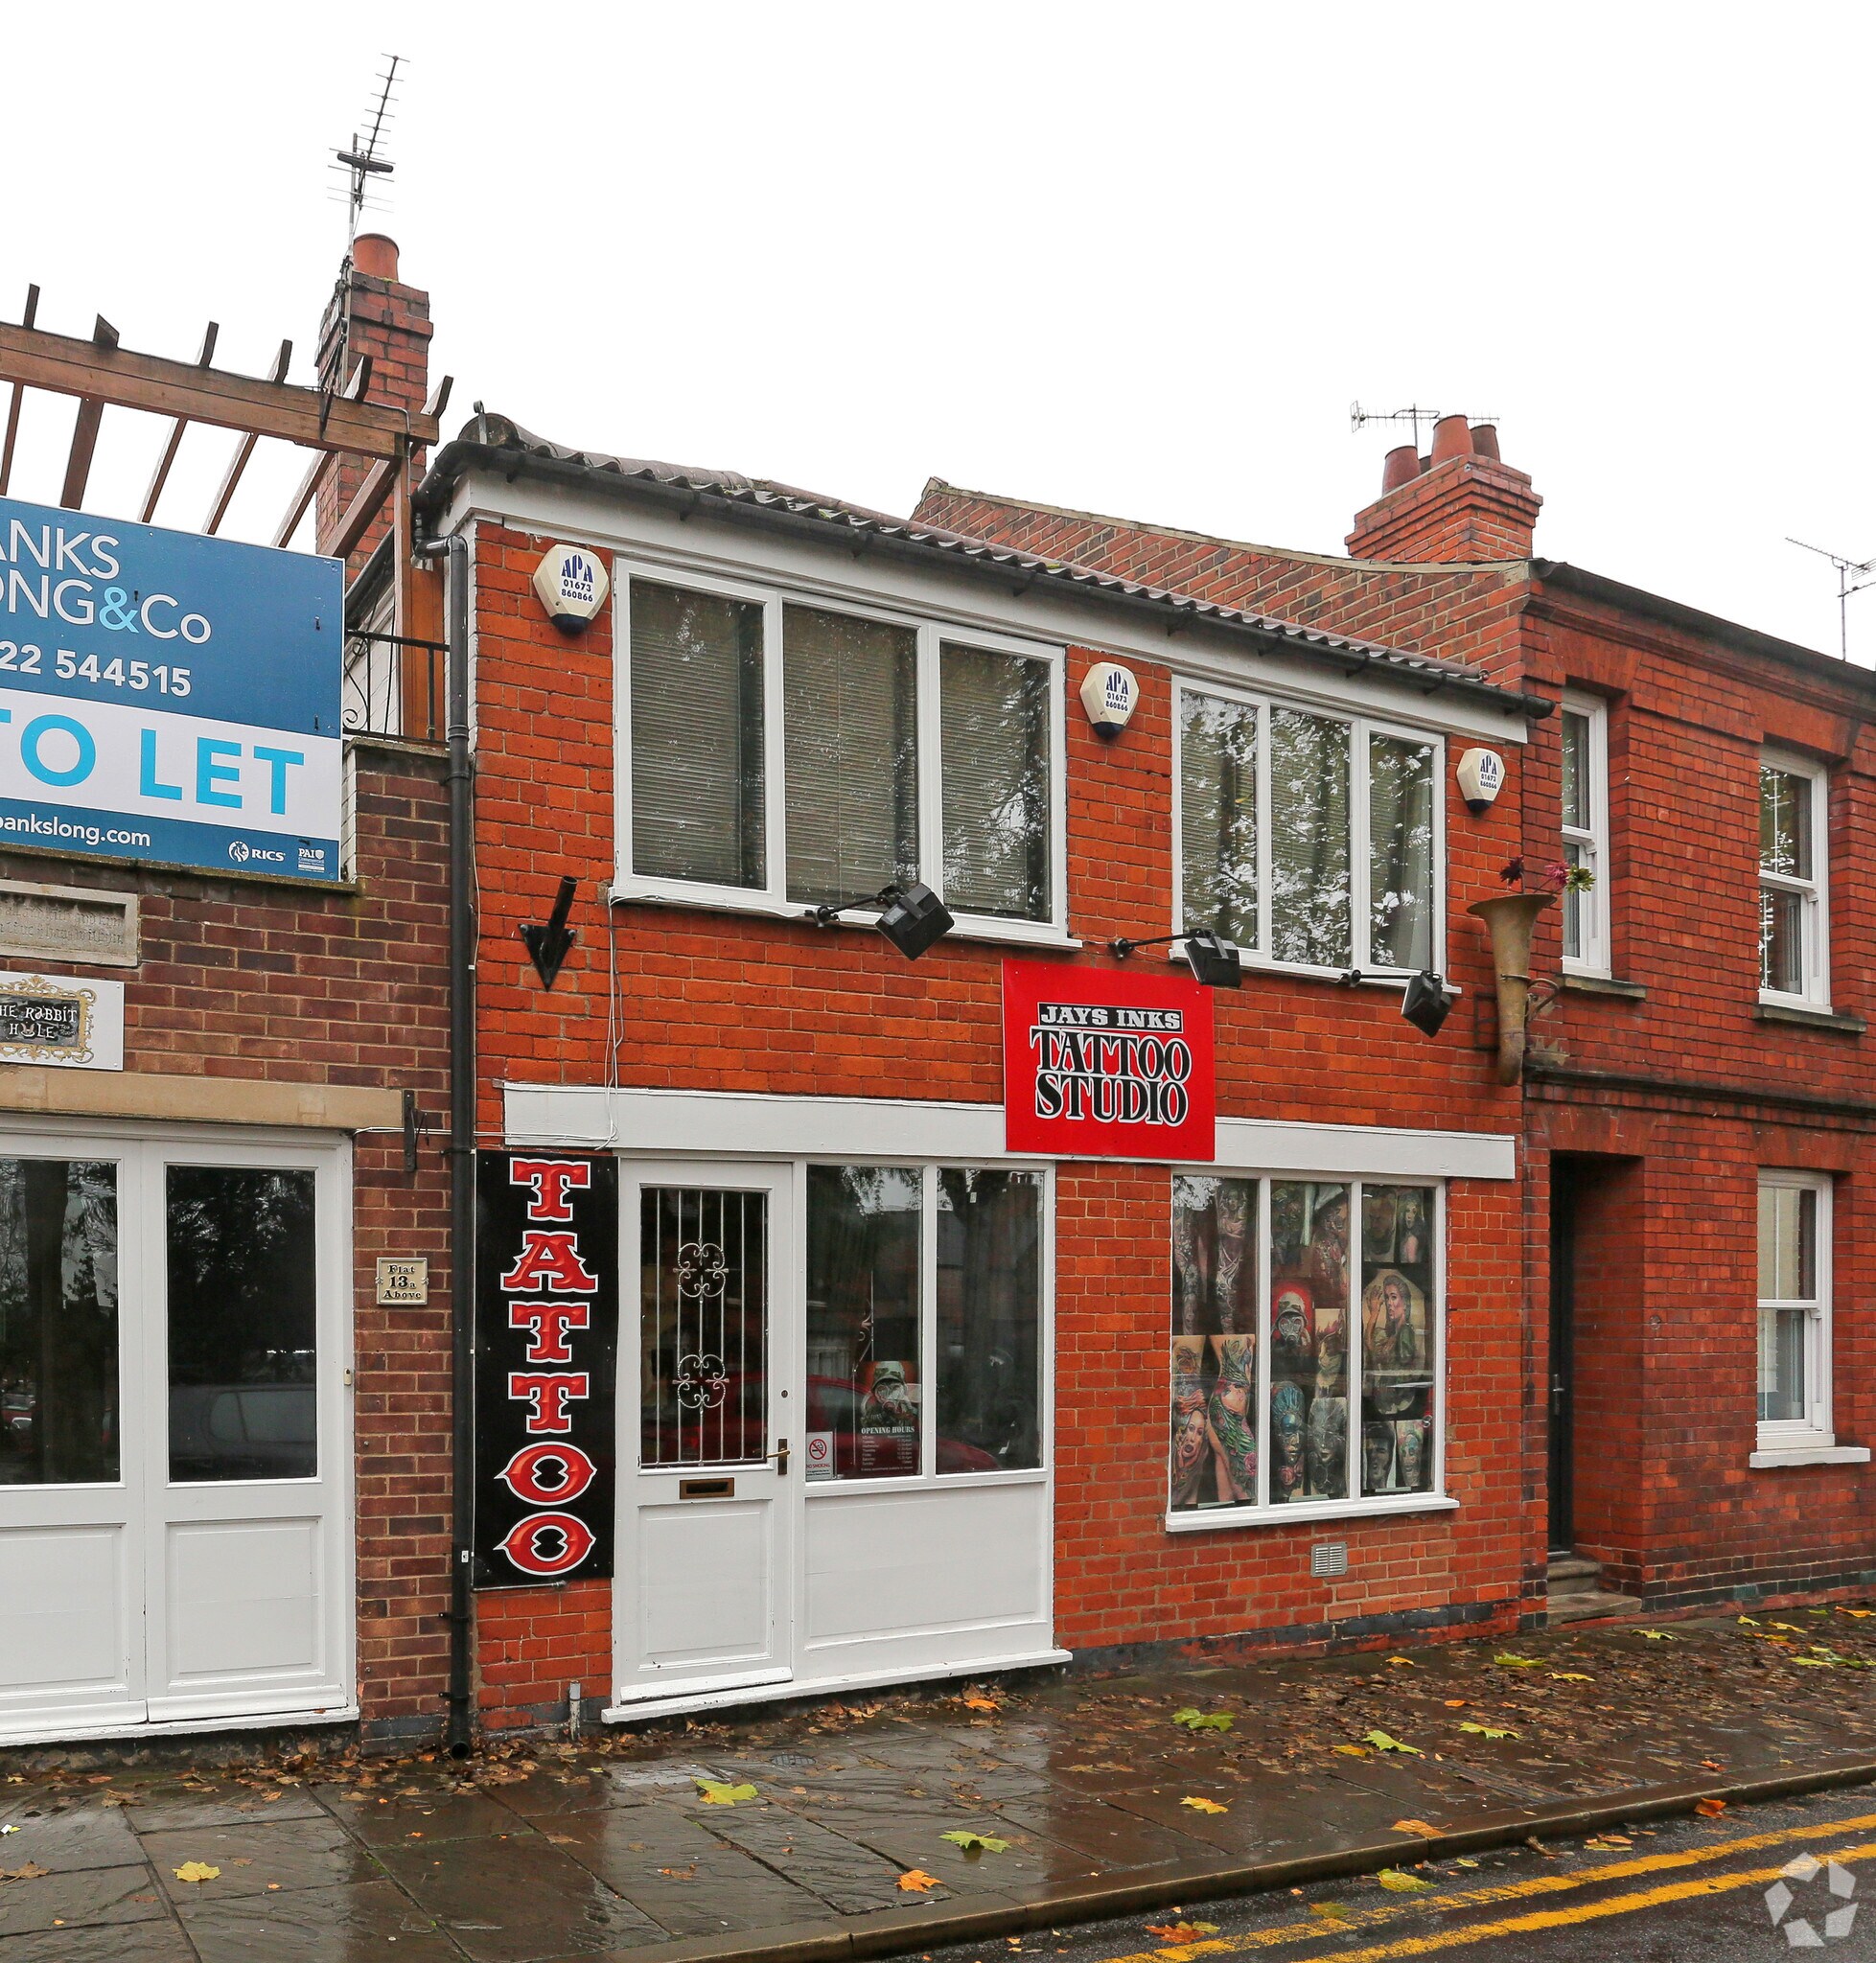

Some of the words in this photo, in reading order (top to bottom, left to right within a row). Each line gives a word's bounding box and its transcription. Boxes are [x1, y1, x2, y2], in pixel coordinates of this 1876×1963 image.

[561, 554, 593, 583] APA
[561, 589, 593, 603] 860866
[563, 579, 591, 592] 01673
[0, 568, 212, 644] NG&Co
[55, 649, 192, 697] 544515
[1106, 671, 1129, 695] APA
[1105, 701, 1129, 712] 860866
[1106, 692, 1127, 704] 01673
[0, 709, 96, 787] O
[140, 727, 305, 816] LET
[1480, 754, 1497, 775] APA
[0, 814, 151, 846] ankslong.com
[251, 848, 285, 862] RICS
[1040, 1005, 1108, 1027] JAYS
[1117, 1009, 1181, 1029] INKS
[1030, 1026, 1192, 1081] TATTOO
[1035, 1073, 1189, 1126] STUDIO
[387, 1264, 415, 1274] Flat
[389, 1275, 416, 1289] 13a
[383, 1289, 422, 1299] Above
[493, 1157, 598, 1576] TATTOO
[861, 1426, 891, 1435] OPENING
[892, 1425, 915, 1434] HOURS
